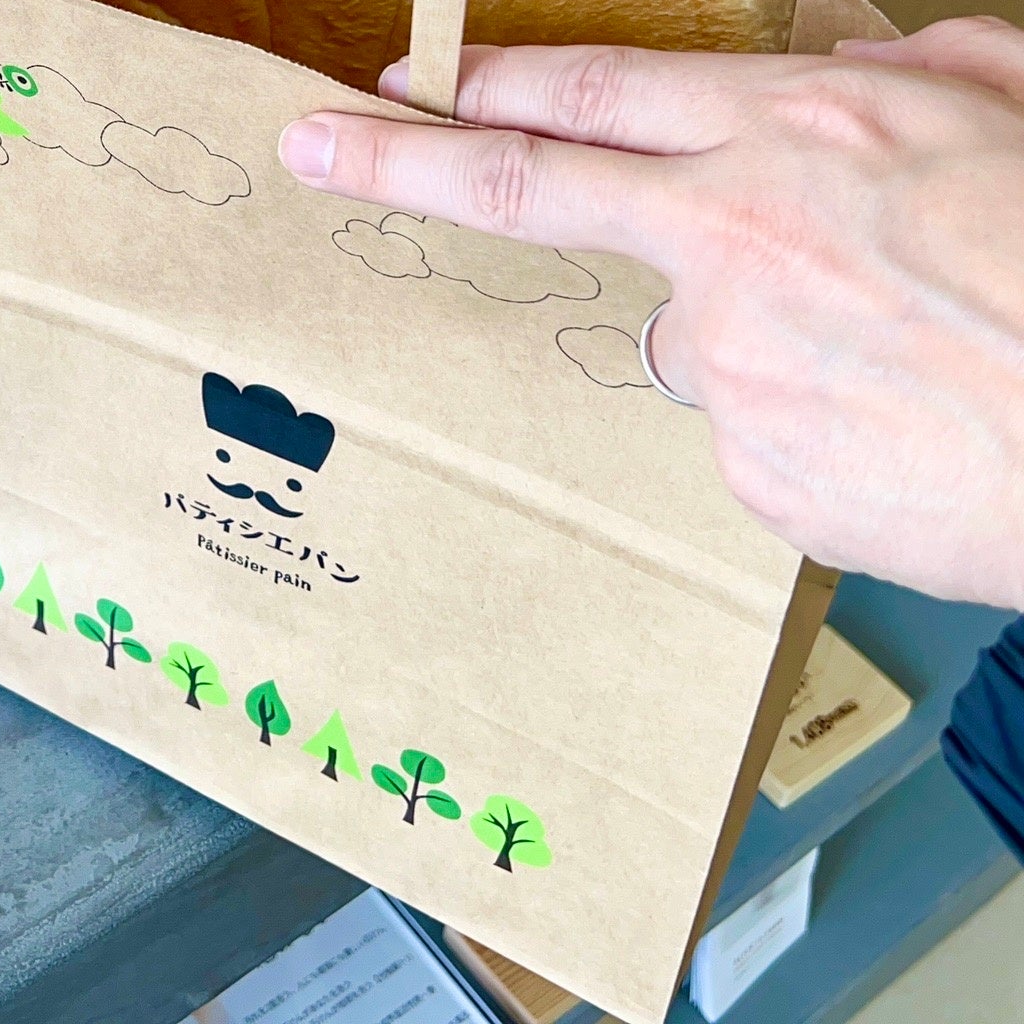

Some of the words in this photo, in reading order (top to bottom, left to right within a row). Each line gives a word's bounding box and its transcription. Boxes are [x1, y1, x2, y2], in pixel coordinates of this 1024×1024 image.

[164, 491, 361, 584] パティシエパン
[197, 533, 269, 575] Pâtissier
[274, 569, 313, 592] pain
